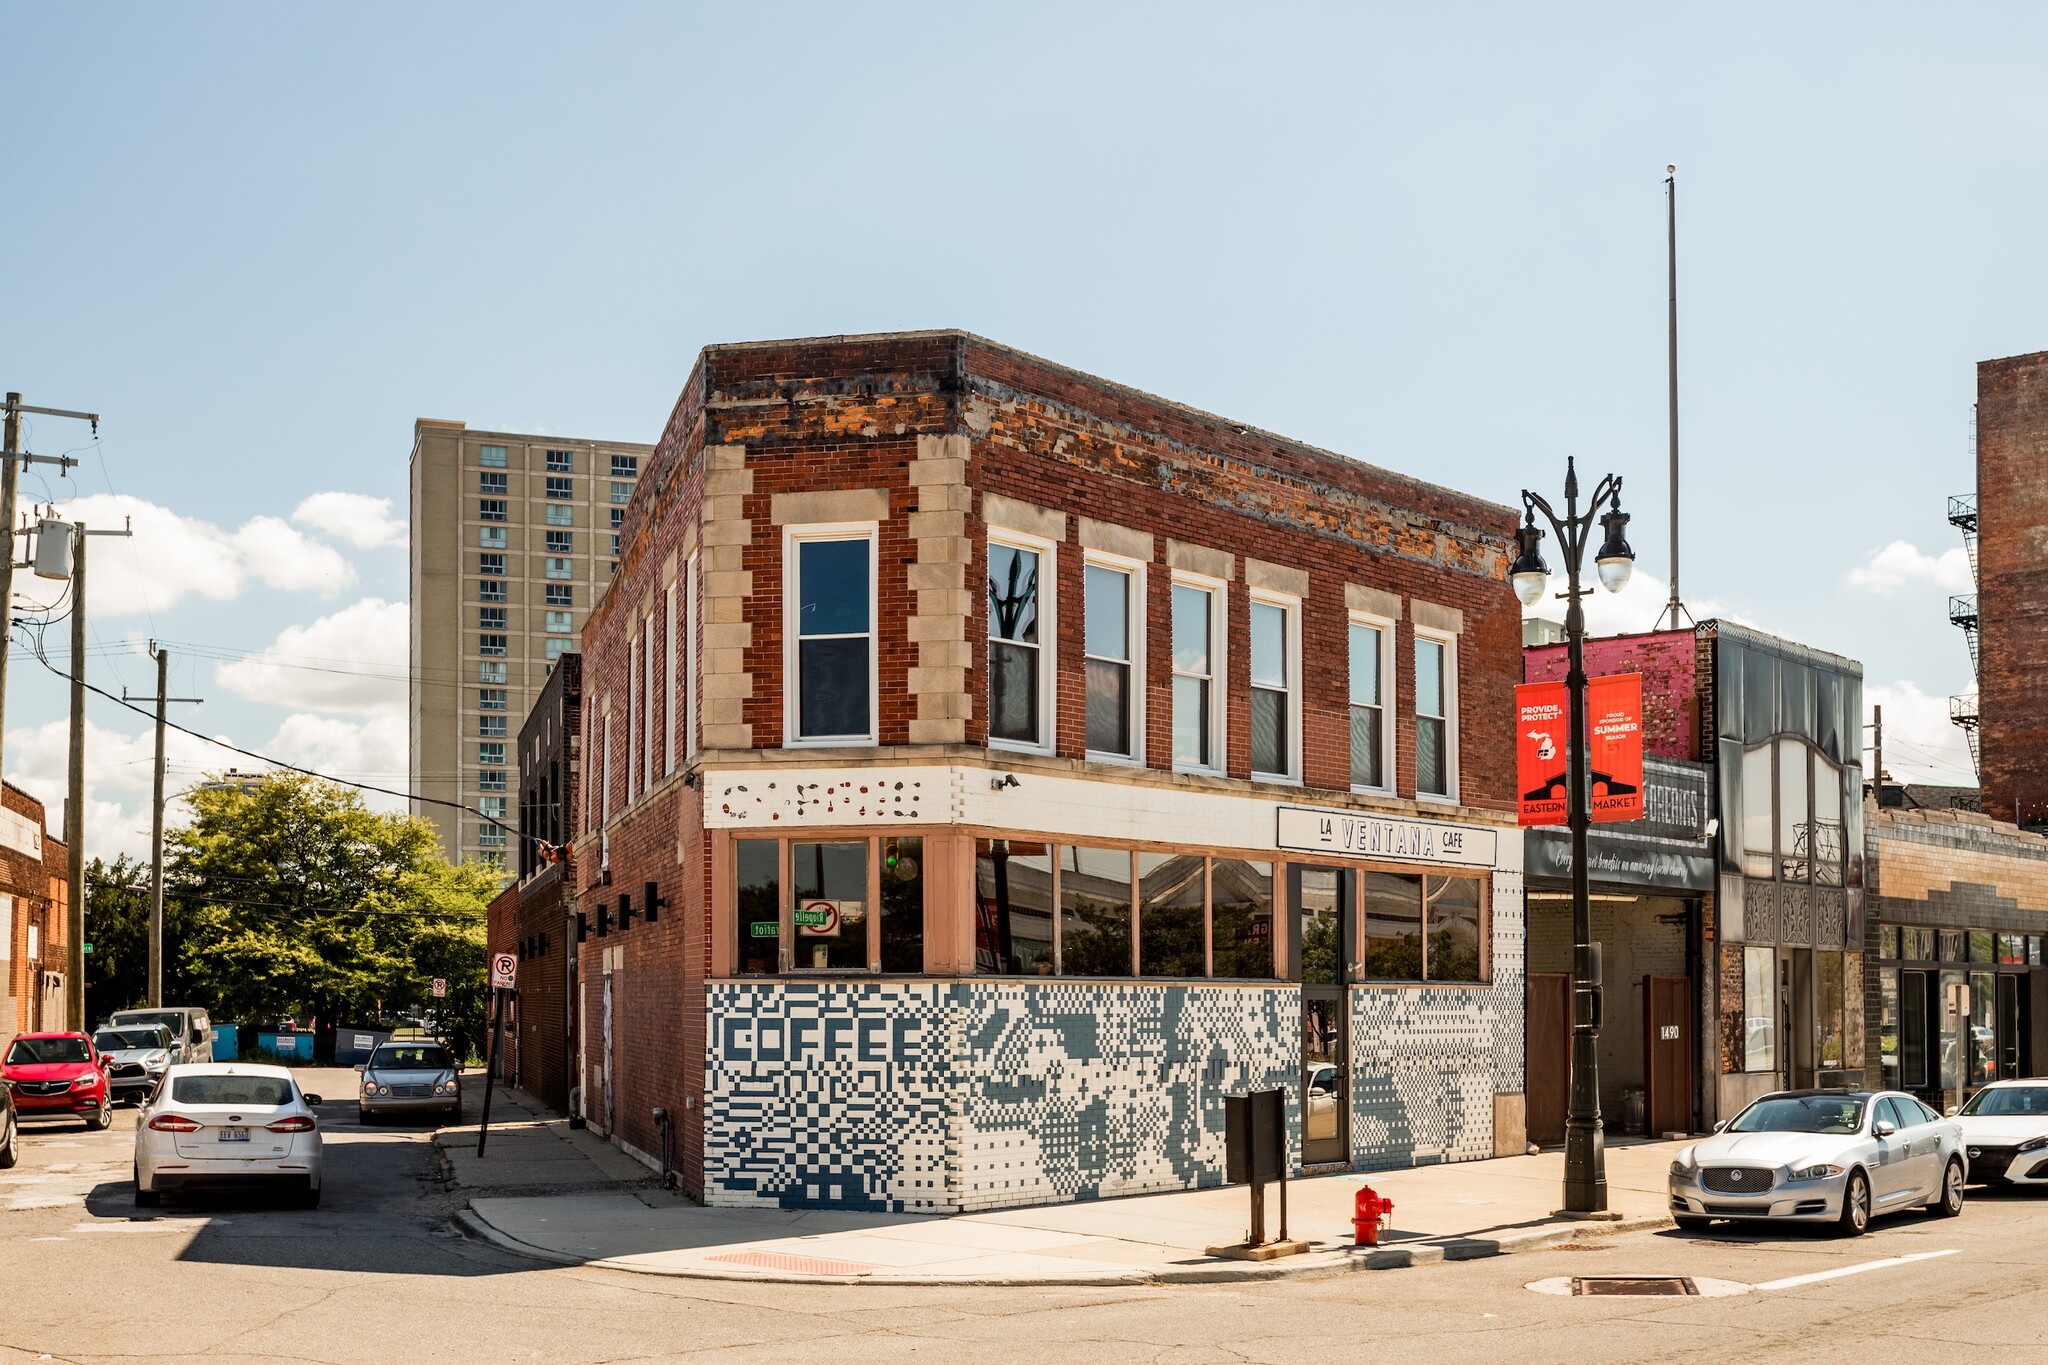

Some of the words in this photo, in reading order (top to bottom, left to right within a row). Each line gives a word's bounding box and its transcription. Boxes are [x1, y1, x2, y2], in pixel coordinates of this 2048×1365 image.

[1521, 704, 1558, 714] PROVIDE
[1521, 712, 1558, 722] PROTECT
[1594, 723, 1638, 735] SUMMER
[1523, 802, 1566, 814] EASTERN
[1593, 797, 1637, 810] MARKET
[1649, 784, 1698, 828] DREAMS
[1320, 818, 1332, 836] LA
[1341, 818, 1435, 857] VENTANA
[1442, 831, 1463, 849] CAFE
[1661, 1025, 1679, 1040] 1490
[723, 1017, 922, 1062] COFFEE
